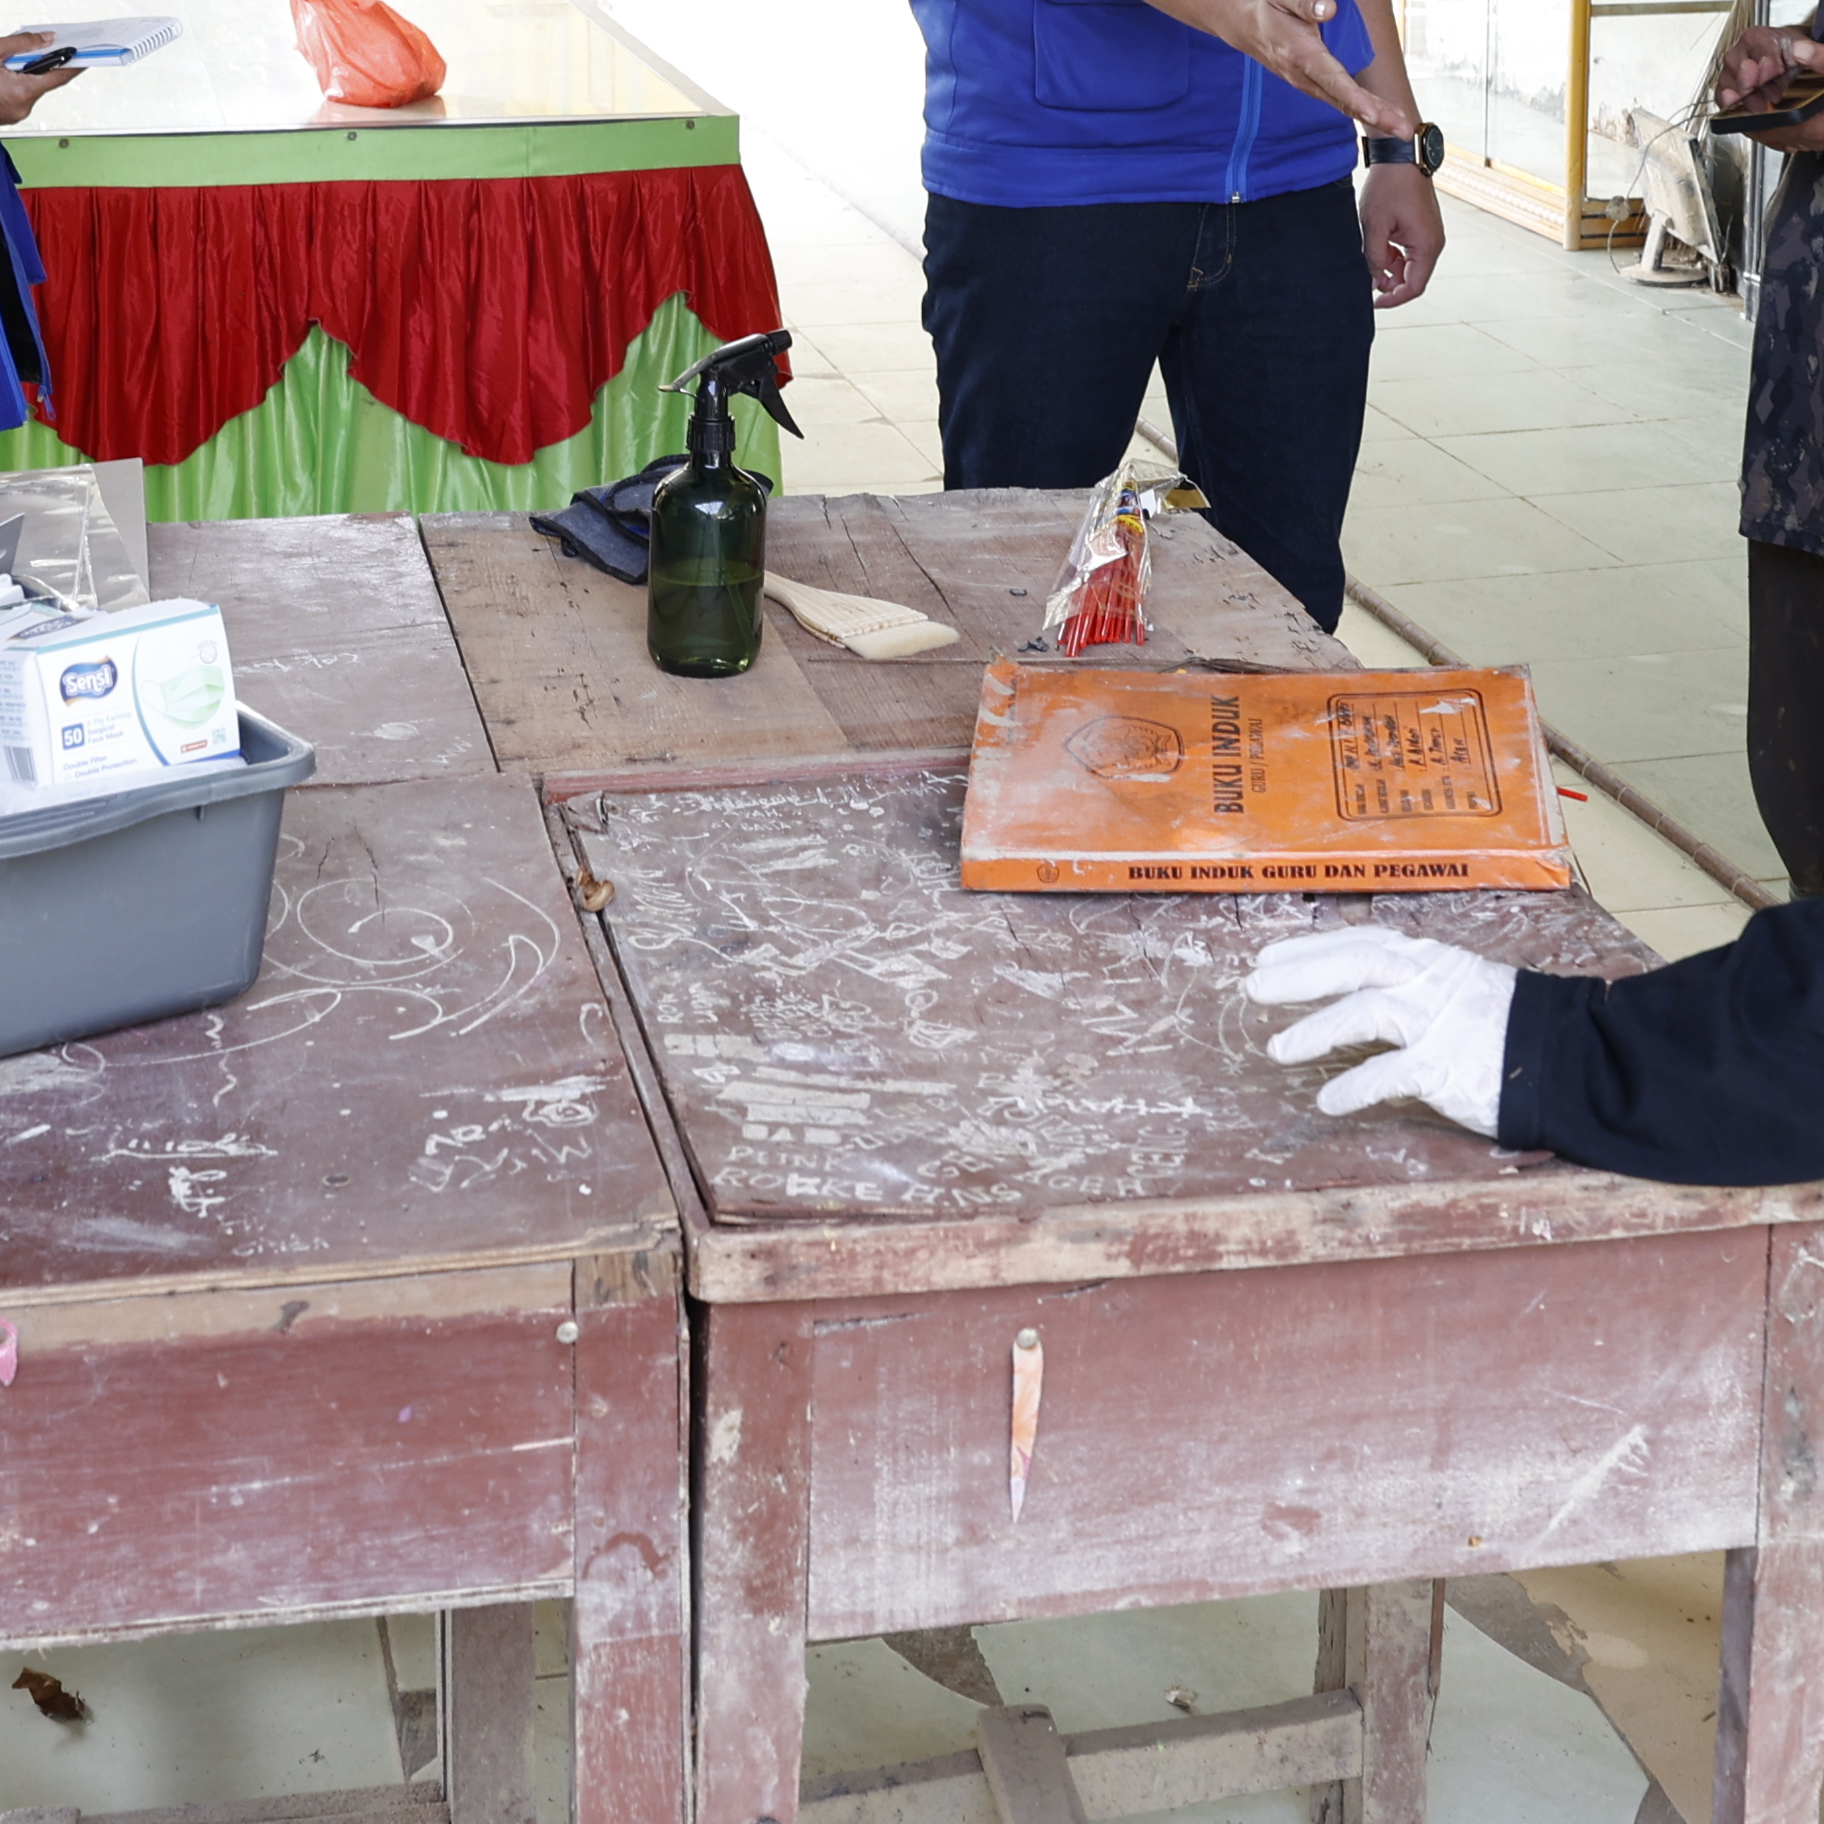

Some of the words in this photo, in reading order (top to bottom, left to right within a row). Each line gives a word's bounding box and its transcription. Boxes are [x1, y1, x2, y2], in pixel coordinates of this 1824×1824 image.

[87, 723, 116, 737] Surgical
[1211, 695, 1242, 758] INDUK
[64, 728, 83, 747] 50
[87, 734, 104, 745] Face
[105, 730, 124, 742] Mask
[1248, 717, 1265, 760] PEGAWAI
[63, 758, 88, 772] Double
[90, 753, 108, 765] Filter
[74, 767, 101, 780] Double
[102, 756, 138, 773] Protection
[1212, 764, 1245, 814] BUKU
[1251, 767, 1267, 793] GURU
[1129, 865, 1184, 881] BUKU
[1190, 864, 1254, 880] INDUK
[1261, 864, 1320, 880] GURU
[1324, 863, 1366, 879] DAN
[1373, 863, 1469, 880] PEGAWAI
